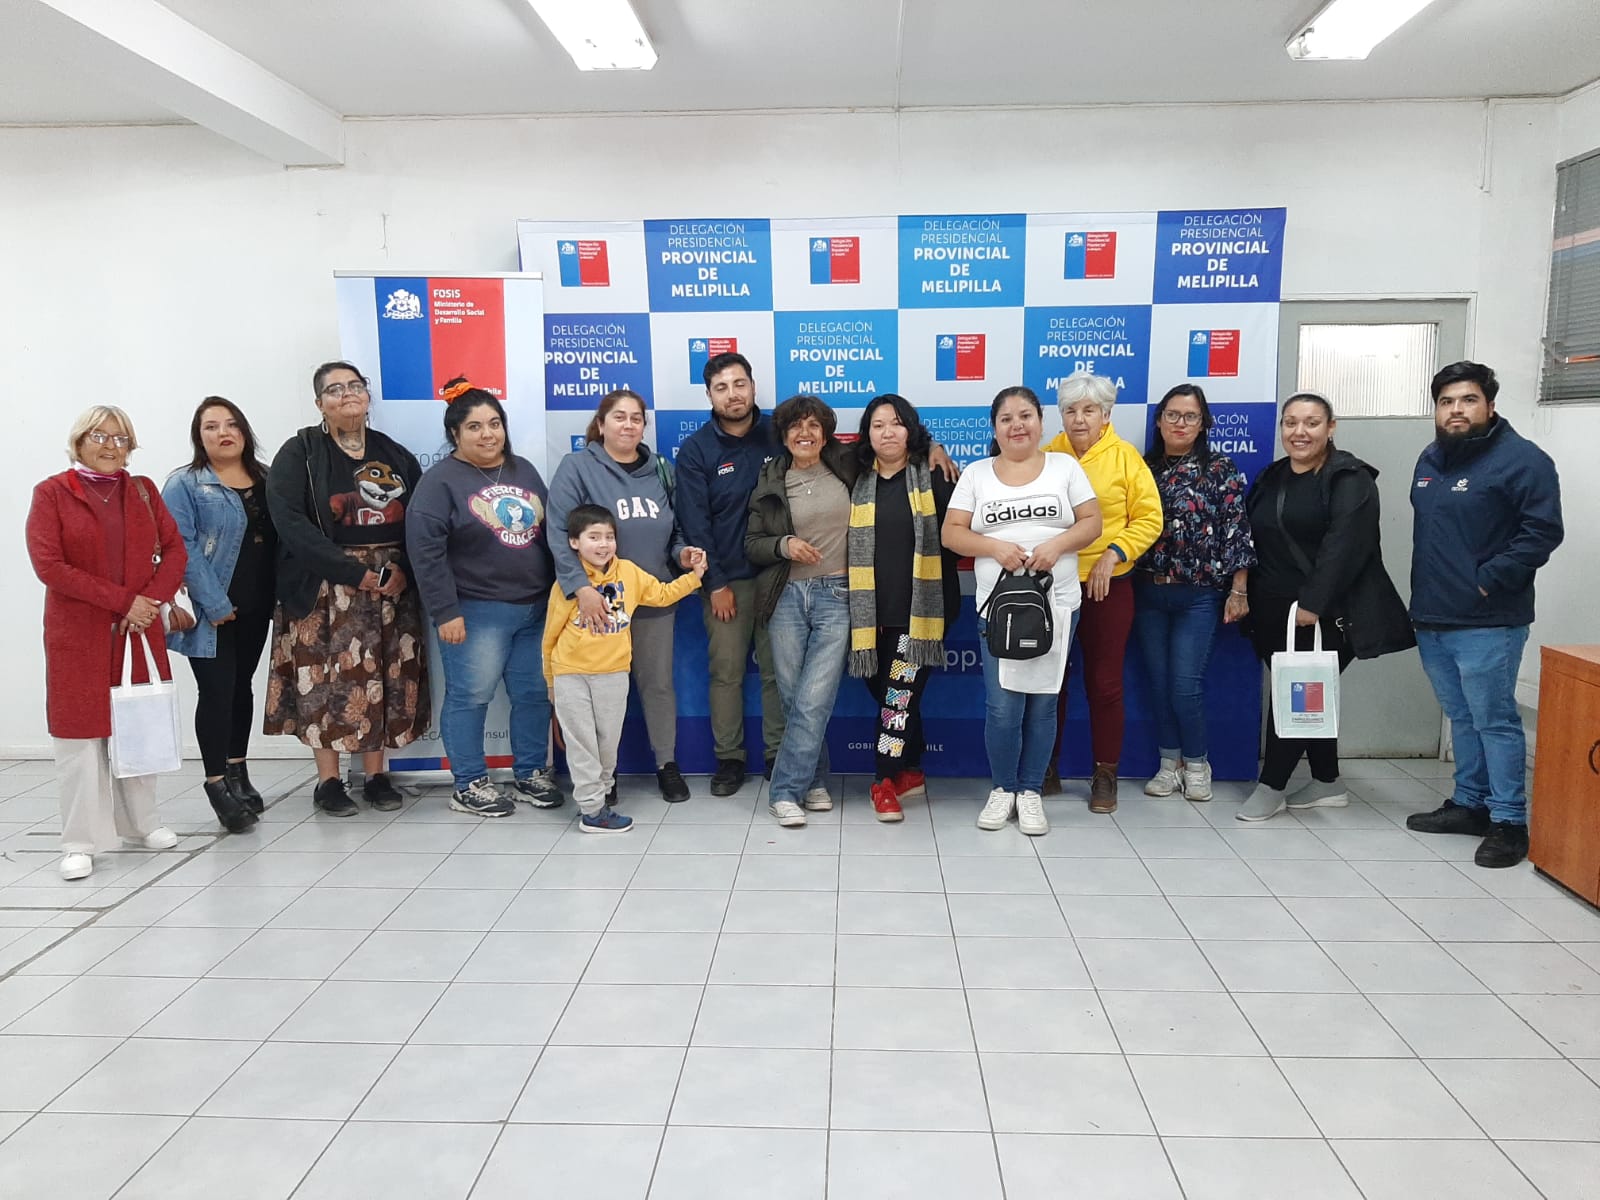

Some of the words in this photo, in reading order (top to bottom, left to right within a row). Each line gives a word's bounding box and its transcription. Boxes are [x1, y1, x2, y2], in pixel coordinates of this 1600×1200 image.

[924, 219, 1000, 231] DELEGACIÓN
[1184, 213, 1262, 226] DELEGACIÓN
[669, 222, 745, 235] DELEGACIÓN
[1180, 227, 1265, 239] PRESIDENCIAL
[668, 237, 748, 248] PRESIDENCIAL
[921, 233, 1004, 244] PRESIDENCIAL
[913, 246, 1010, 261] PROVINCIAL
[1171, 240, 1270, 256] PROVINCIAL
[661, 250, 757, 265] PROVINCIAL
[949, 263, 970, 277] DE
[1207, 258, 1229, 272] DE
[698, 267, 718, 281] DE
[921, 280, 1002, 293] MELIPILLA
[1177, 274, 1259, 289] MELIPILLA
[433, 289, 461, 299] FOSIS
[671, 283, 751, 297] MELIPILLA
[799, 320, 873, 333] DELEGACIÓN
[1050, 315, 1125, 329] DELEGACIÓN
[552, 323, 625, 336] DELEGACIÓN
[550, 338, 629, 348] PRESIDENCIAL
[797, 335, 877, 346] PRESIDENCIAL
[1047, 331, 1128, 342] PRESIDENCIAL
[544, 351, 638, 364] PROVINCIAL
[789, 348, 884, 362] PROVINCIAL
[1039, 344, 1135, 358] PROVINCIAL
[580, 367, 600, 380] DE
[825, 365, 845, 378] DE
[1074, 361, 1095, 373] DE
[798, 380, 876, 394] MELIPILLA
[1208, 440, 1258, 453] NCIAL
[481, 485, 524, 500] FIERCE
[616, 496, 660, 521] GAP
[985, 504, 1058, 524] adidas
[500, 529, 536, 546] GRACE
